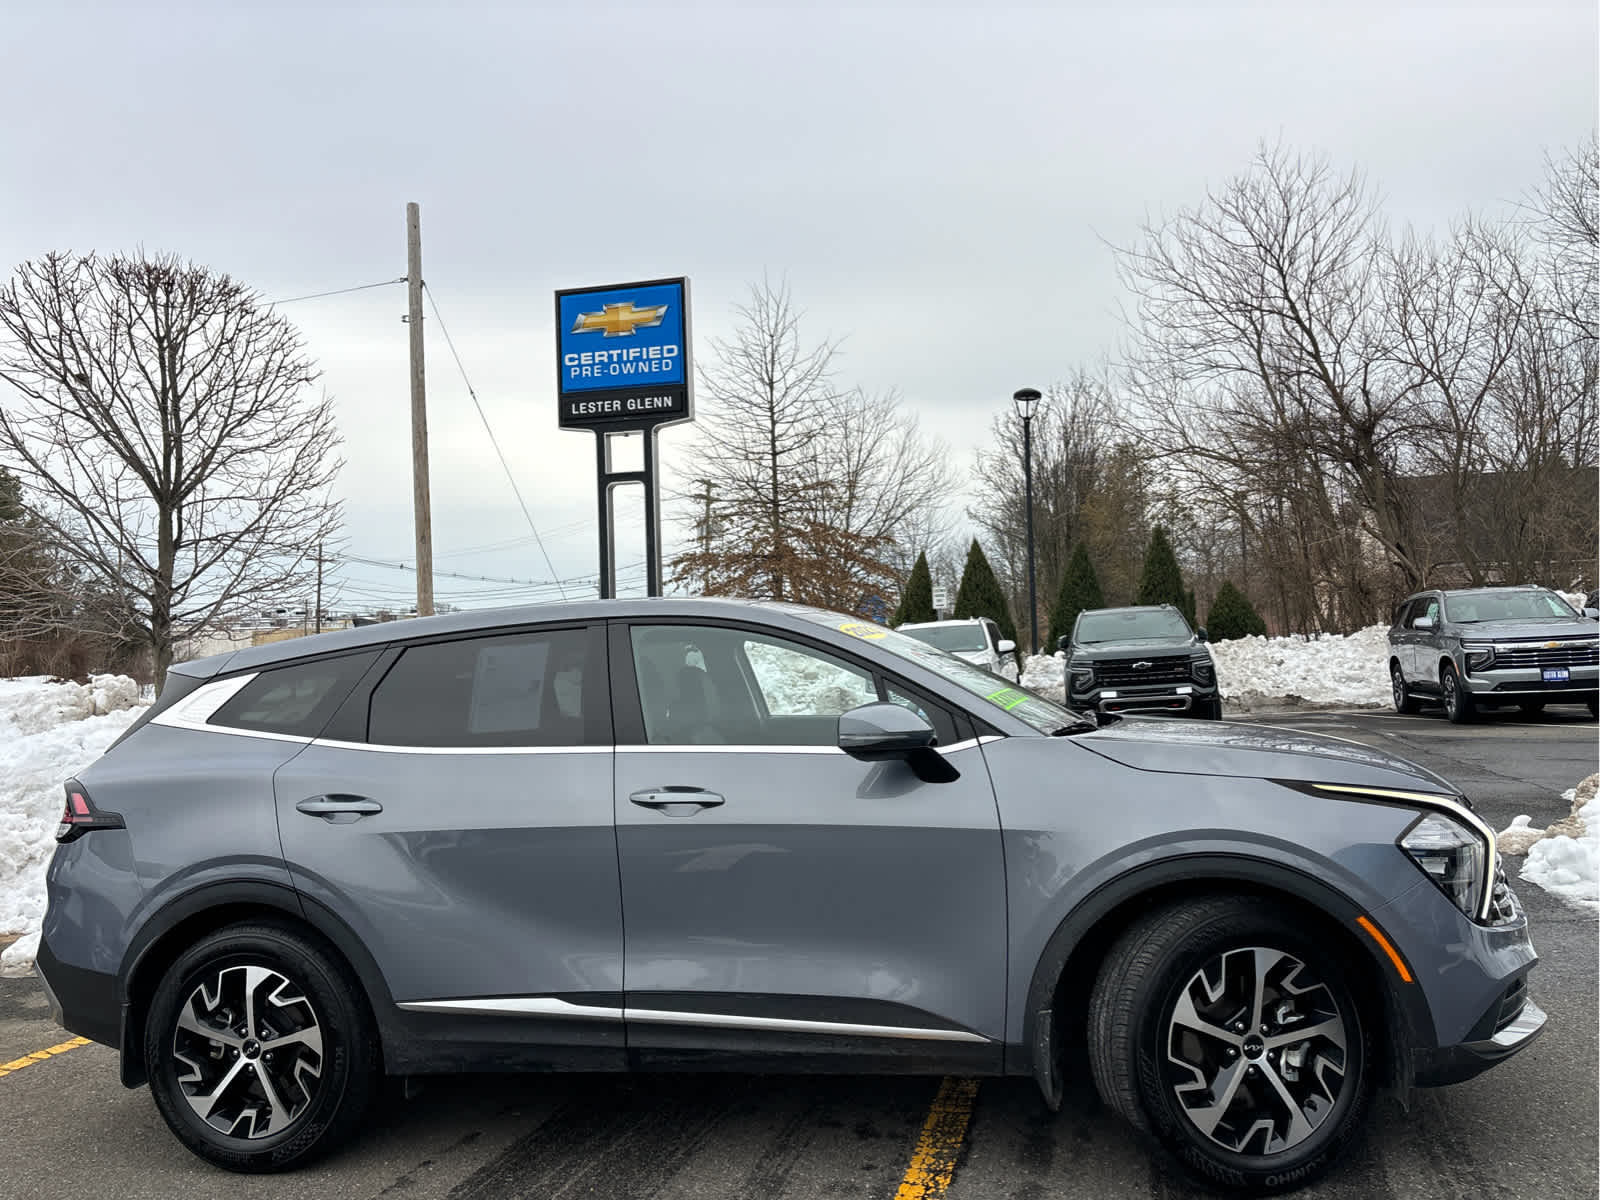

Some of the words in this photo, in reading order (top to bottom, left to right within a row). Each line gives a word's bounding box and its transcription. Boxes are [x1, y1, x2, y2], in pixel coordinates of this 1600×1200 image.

[564, 344, 678, 366] CERTIFIED
[570, 359, 673, 379] PRE-OWNED
[571, 400, 622, 414] LESTER
[627, 396, 672, 410] GLENN
